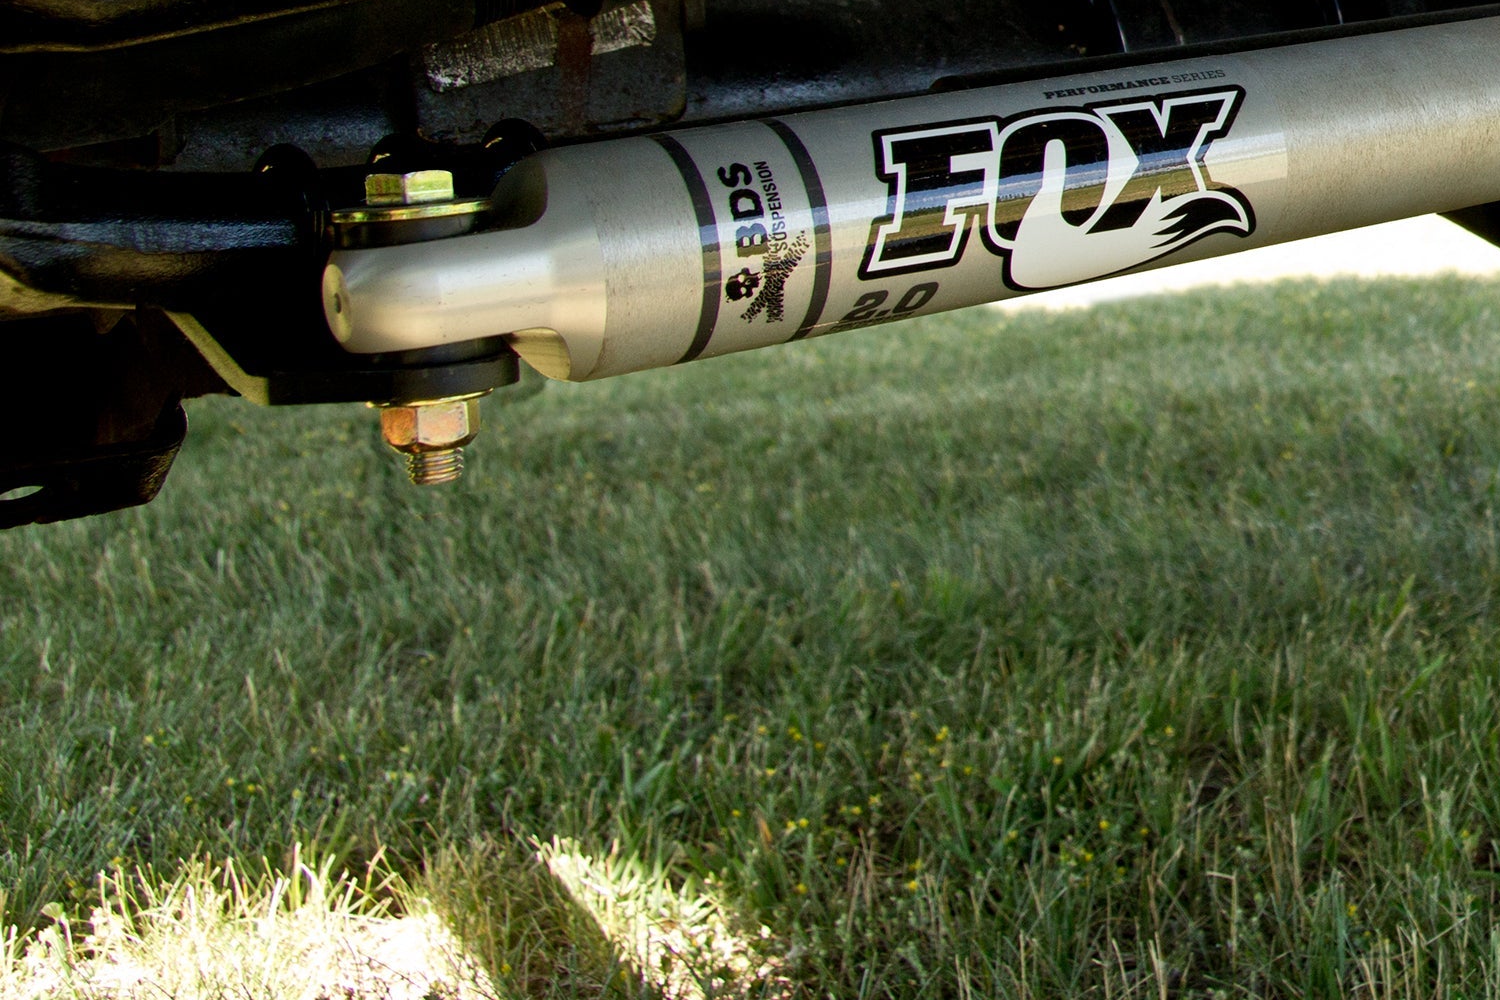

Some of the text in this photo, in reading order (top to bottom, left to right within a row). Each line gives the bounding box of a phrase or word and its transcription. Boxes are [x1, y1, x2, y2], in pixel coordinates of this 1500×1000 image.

[1043, 69, 1226, 100] PERFORMANCE SERIES
[717, 162, 768, 258] BDS
[753, 161, 788, 251] SUSPENSION
[858, 84, 1252, 289] FOX
[840, 281, 940, 321] 2.0
